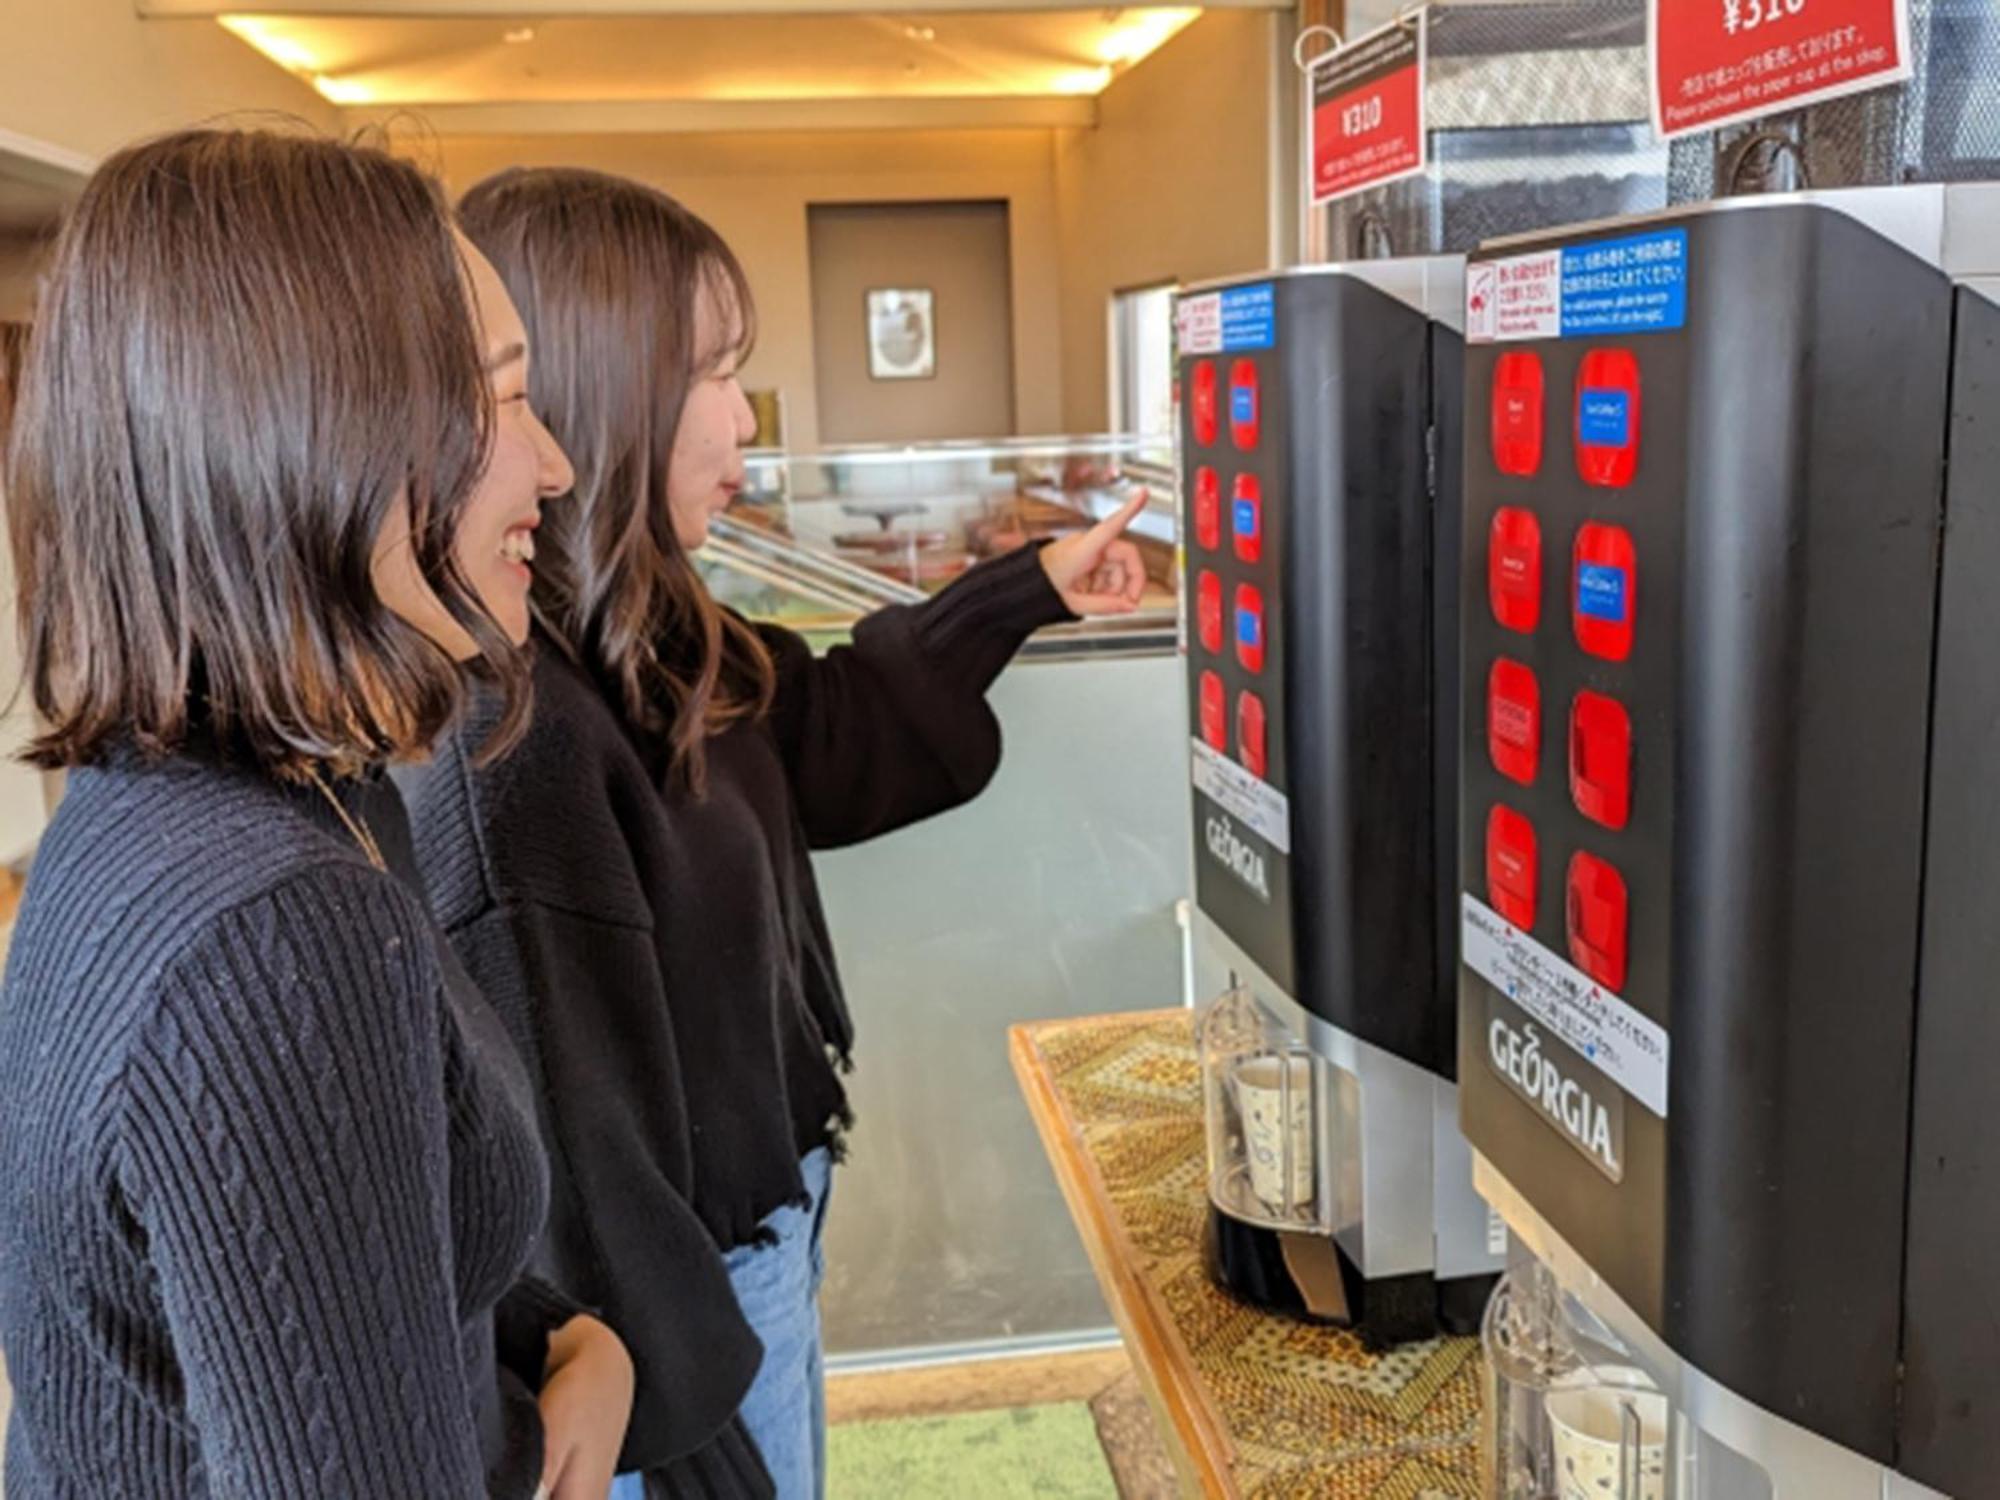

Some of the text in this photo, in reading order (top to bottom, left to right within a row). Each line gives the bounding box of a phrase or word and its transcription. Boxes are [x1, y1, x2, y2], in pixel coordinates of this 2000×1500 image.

[1723, 0, 1805, 35] ¥31
[1795, 66, 1816, 84] cup
[1833, 55, 1853, 74] the
[1489, 1018, 1619, 1167] GEORGIA
